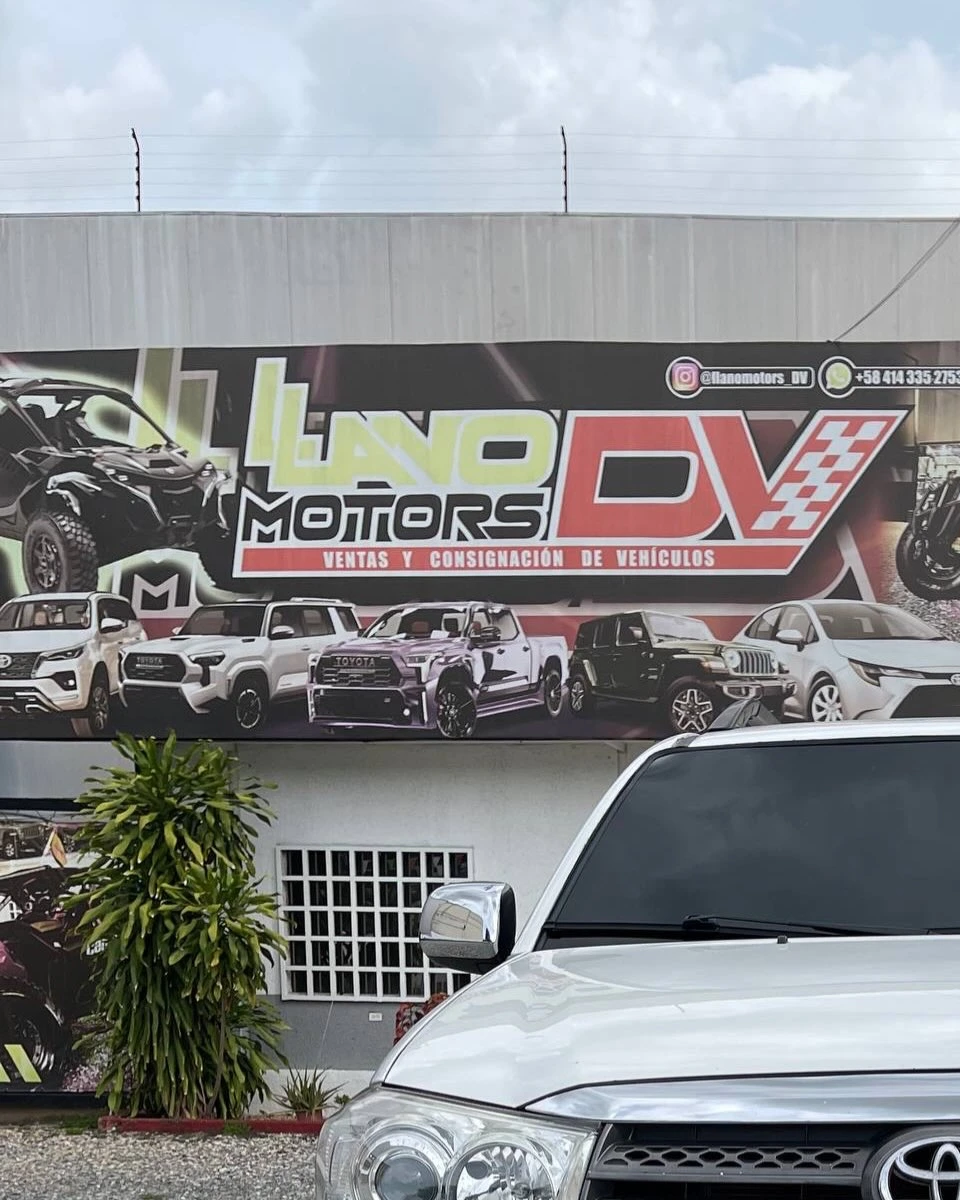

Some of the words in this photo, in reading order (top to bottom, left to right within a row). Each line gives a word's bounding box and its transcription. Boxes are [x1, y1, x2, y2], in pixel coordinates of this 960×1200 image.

[855, 370, 881, 385] +58
[882, 370, 904, 385] 414
[906, 370, 931, 385] 335
[553, 412, 905, 539] DV
[242, 493, 547, 542] MOTORS
[323, 551, 389, 569] VENTAS
[402, 551, 413, 568] Y
[430, 547, 564, 568] CONSIGNACIÓN
[581, 550, 603, 567] DE
[616, 547, 715, 567] VEHÍCULOS
[335, 657, 375, 667] TOYOTA
